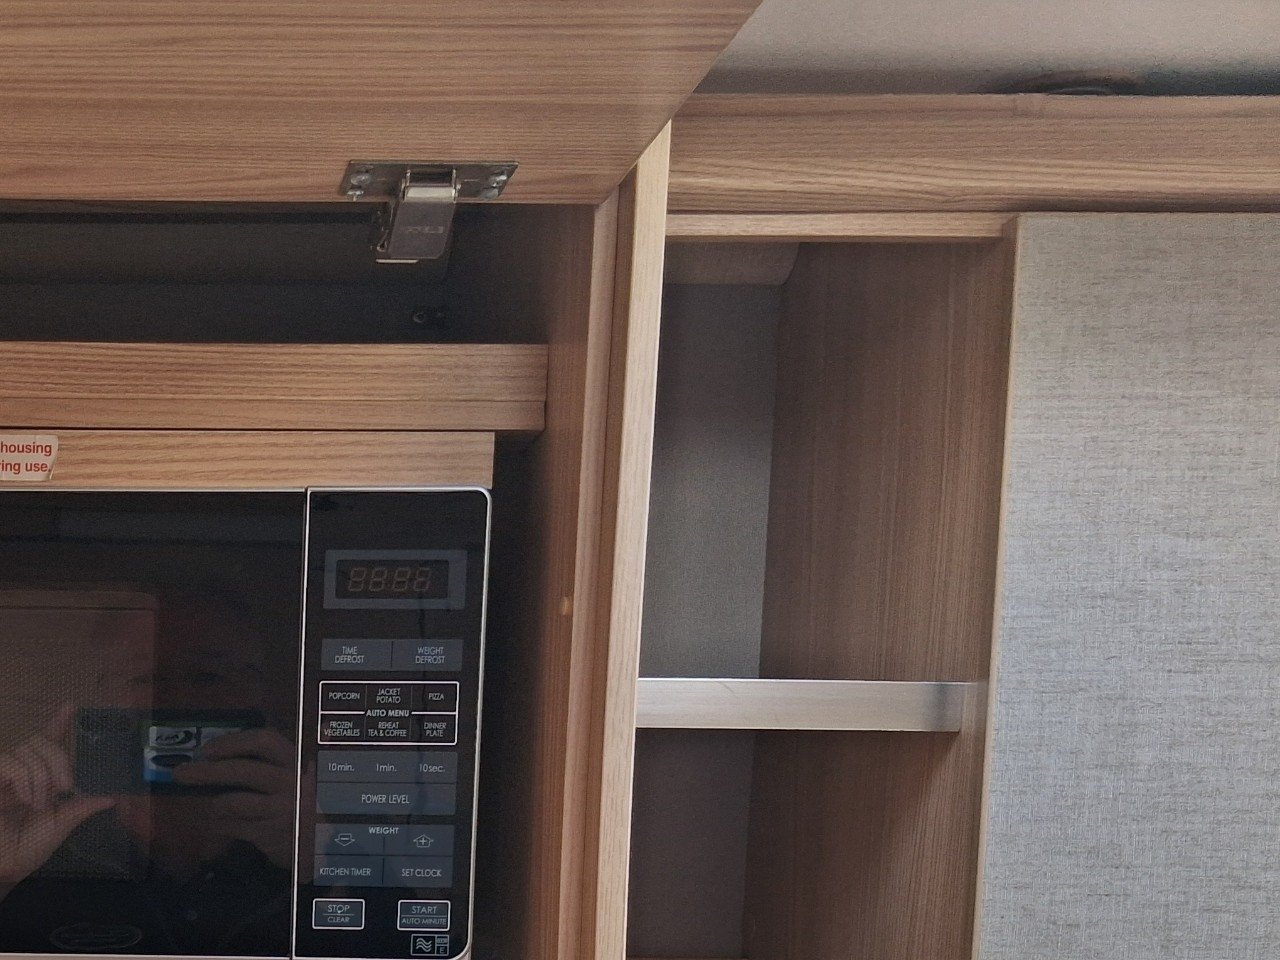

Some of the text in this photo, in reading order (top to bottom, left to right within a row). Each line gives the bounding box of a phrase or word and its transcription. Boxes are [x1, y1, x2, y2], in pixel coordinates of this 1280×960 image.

[0, 441, 52, 457] housing
[25, 462, 51, 473] use.
[342, 646, 358, 655] TIME
[417, 646, 444, 655] WEIGHT
[334, 655, 365, 664] DEFROST
[415, 655, 446, 664] DEFROST
[328, 692, 360, 700] POPCORN
[377, 688, 401, 696] JACKET
[376, 696, 401, 704] POTATO
[428, 693, 445, 701] PIZZA
[366, 709, 410, 717] AUTO MENU
[329, 721, 353, 729] FROZEN
[378, 721, 400, 729] REHEAT
[424, 722, 447, 730] DINNER
[323, 729, 361, 737] VEGETABLES
[368, 729, 379, 737] TEA
[385, 729, 407, 737] COFFEE
[361, 794, 410, 804] POWER LEVEL
[368, 826, 399, 835] WEIGHT
[320, 868, 371, 876] KITCHEN TIMER
[401, 868, 442, 877] SET CLOCK
[327, 904, 350, 914] STOP
[411, 905, 438, 914] START
[327, 916, 350, 924] CLEAR
[401, 917, 447, 926] AUTO MINUTE
